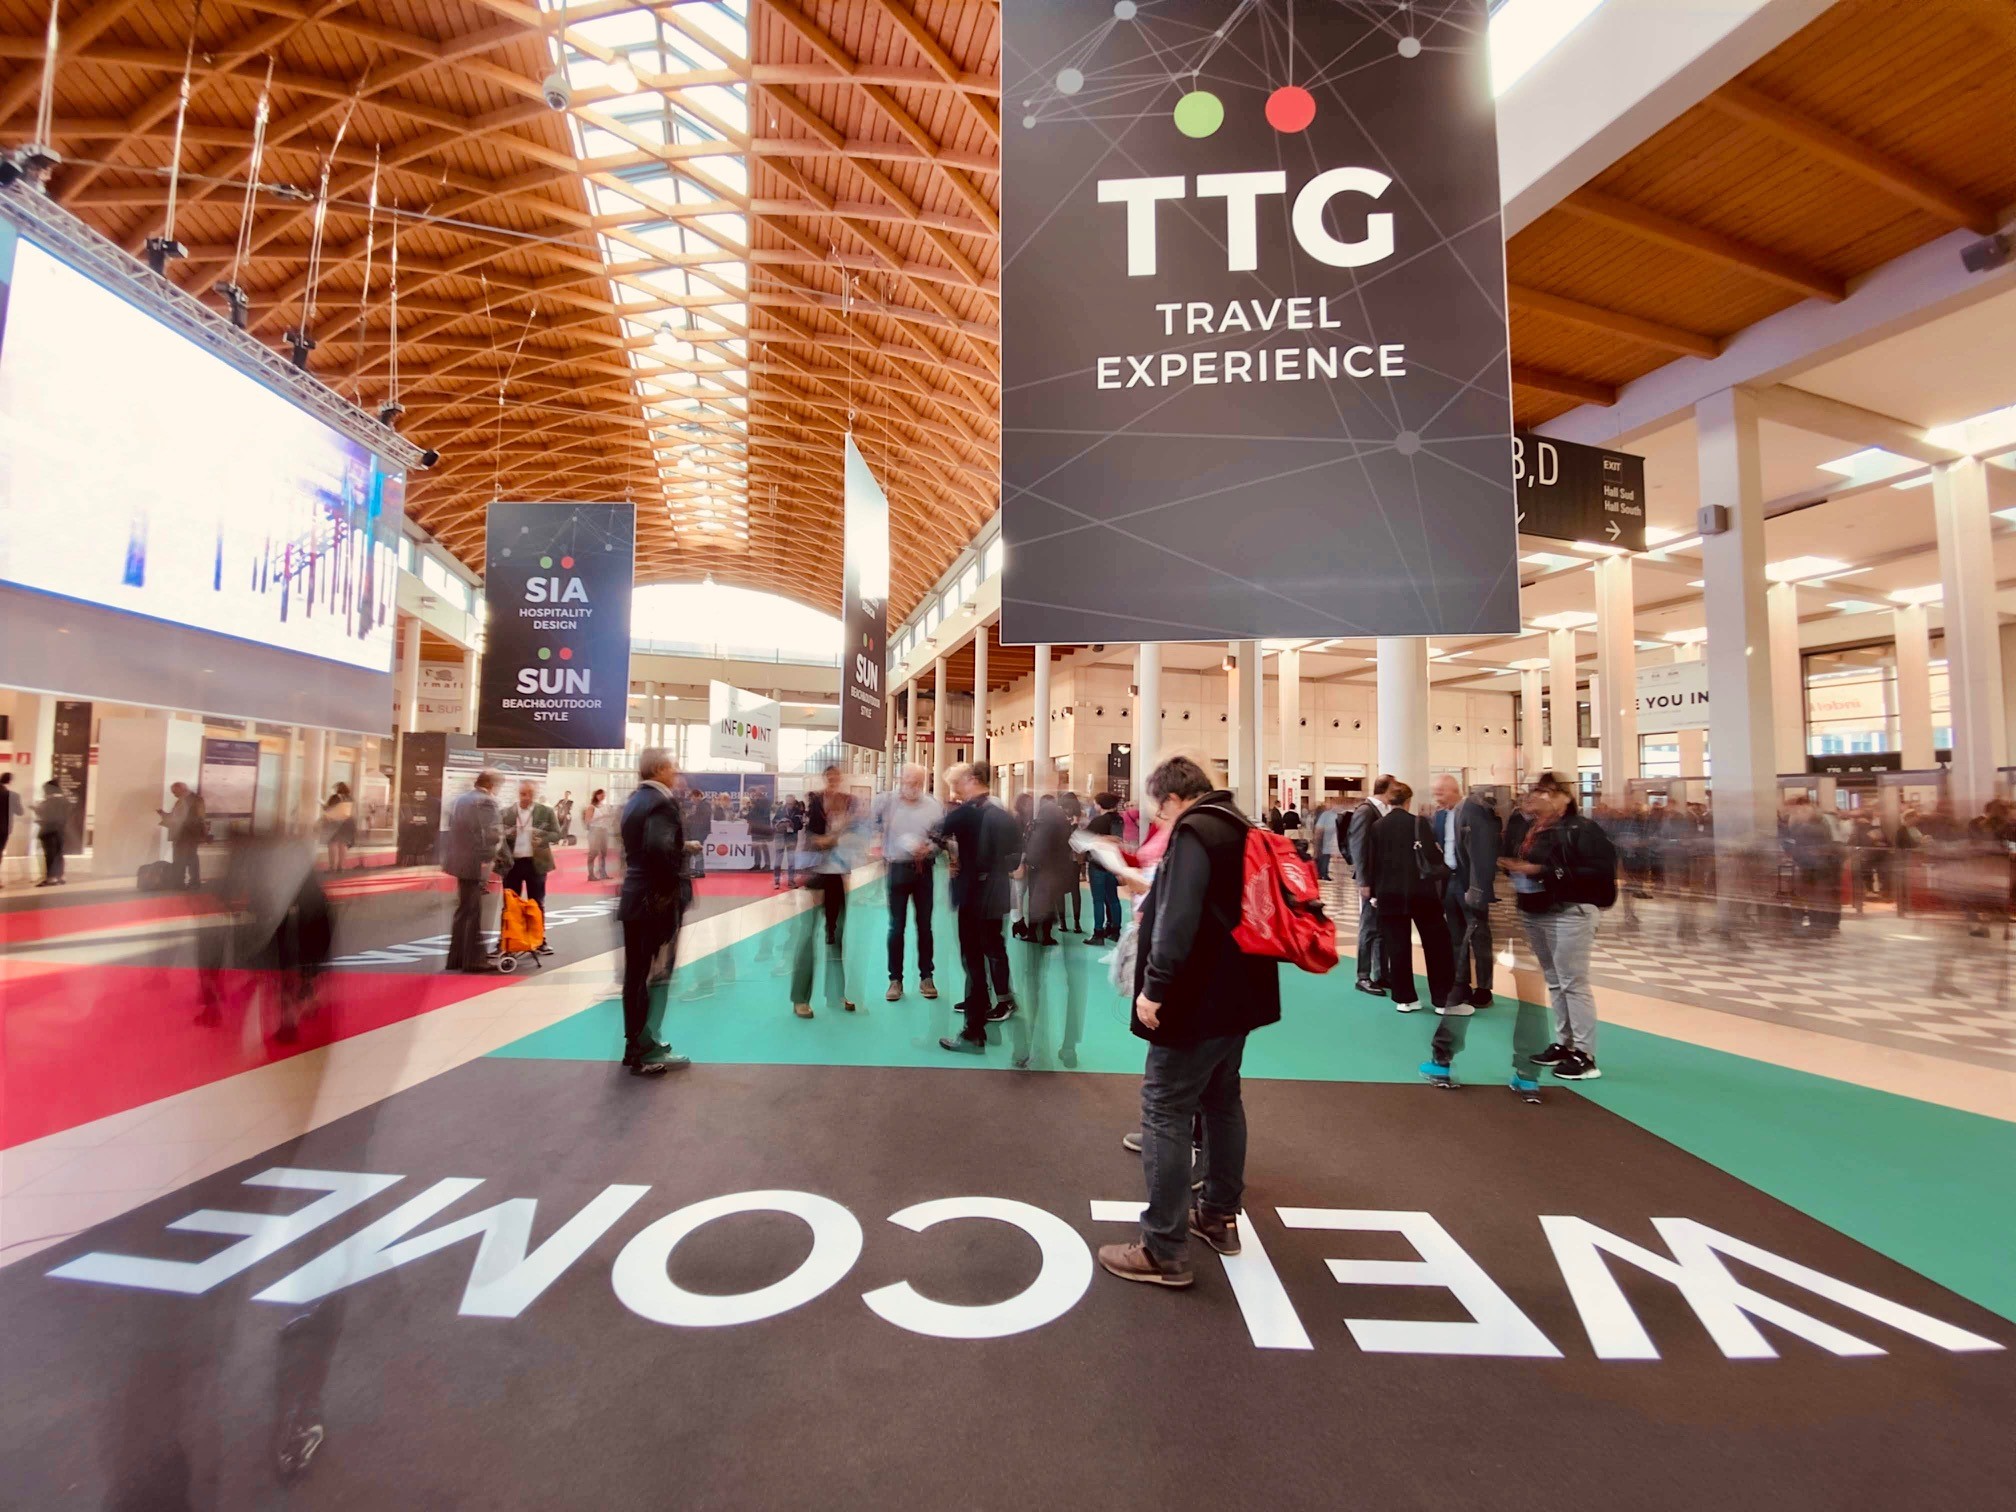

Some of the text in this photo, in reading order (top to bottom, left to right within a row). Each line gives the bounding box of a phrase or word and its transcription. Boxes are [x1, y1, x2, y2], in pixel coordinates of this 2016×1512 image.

[1097, 166, 1395, 277] TTG
[1155, 296, 1342, 336] TRAVEL
[1097, 344, 1407, 390] EXPERIENCE
[1603, 460, 1622, 471] EXIT
[1603, 485, 1635, 501] Hall Sud
[1604, 500, 1642, 516] Hall South
[524, 576, 589, 603] SIA
[519, 608, 593, 618] HOSPITALITY
[533, 620, 577, 630] DESIGN
[855, 652, 878, 693] SUN
[516, 667, 591, 695] SUN
[502, 698, 602, 709] BEACH&OUTDOOR
[1645, 693, 1684, 709] YOU
[533, 711, 569, 722] STYLE
[860, 705, 873, 719] STYLE
[721, 717, 772, 743] INFO POINT
[46, 1168, 2003, 1359] WELCOME
